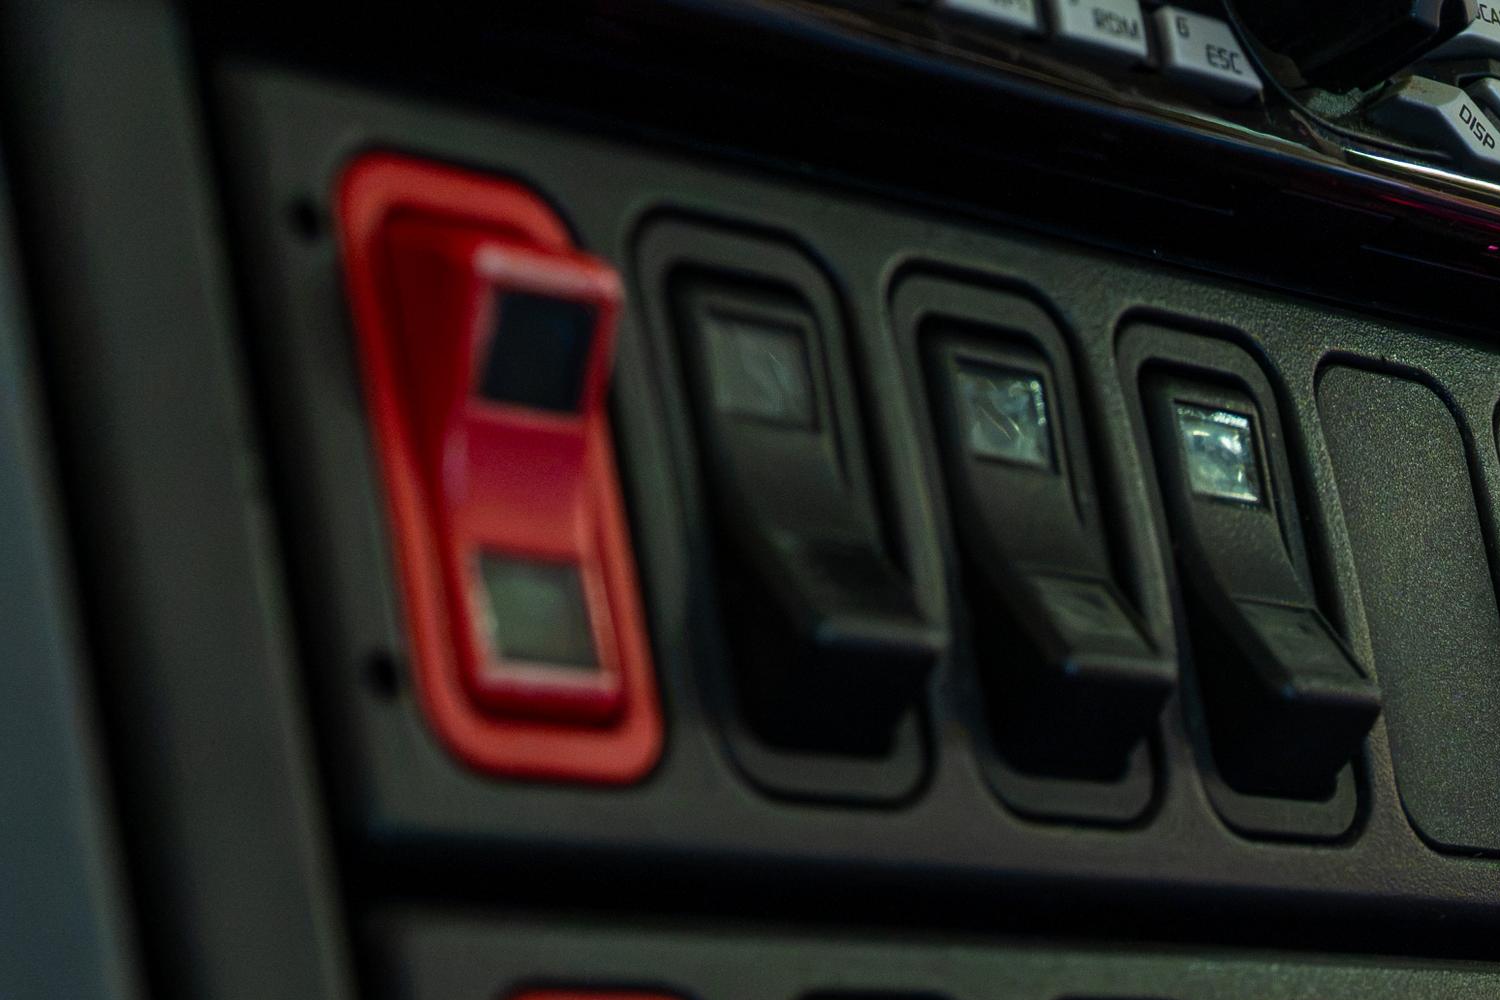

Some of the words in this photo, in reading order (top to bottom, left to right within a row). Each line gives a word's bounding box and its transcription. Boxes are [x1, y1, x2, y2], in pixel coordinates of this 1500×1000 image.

[1175, 16, 1190, 38] 6
[1205, 44, 1243, 74] ESC
[1459, 103, 1496, 150] DISP
